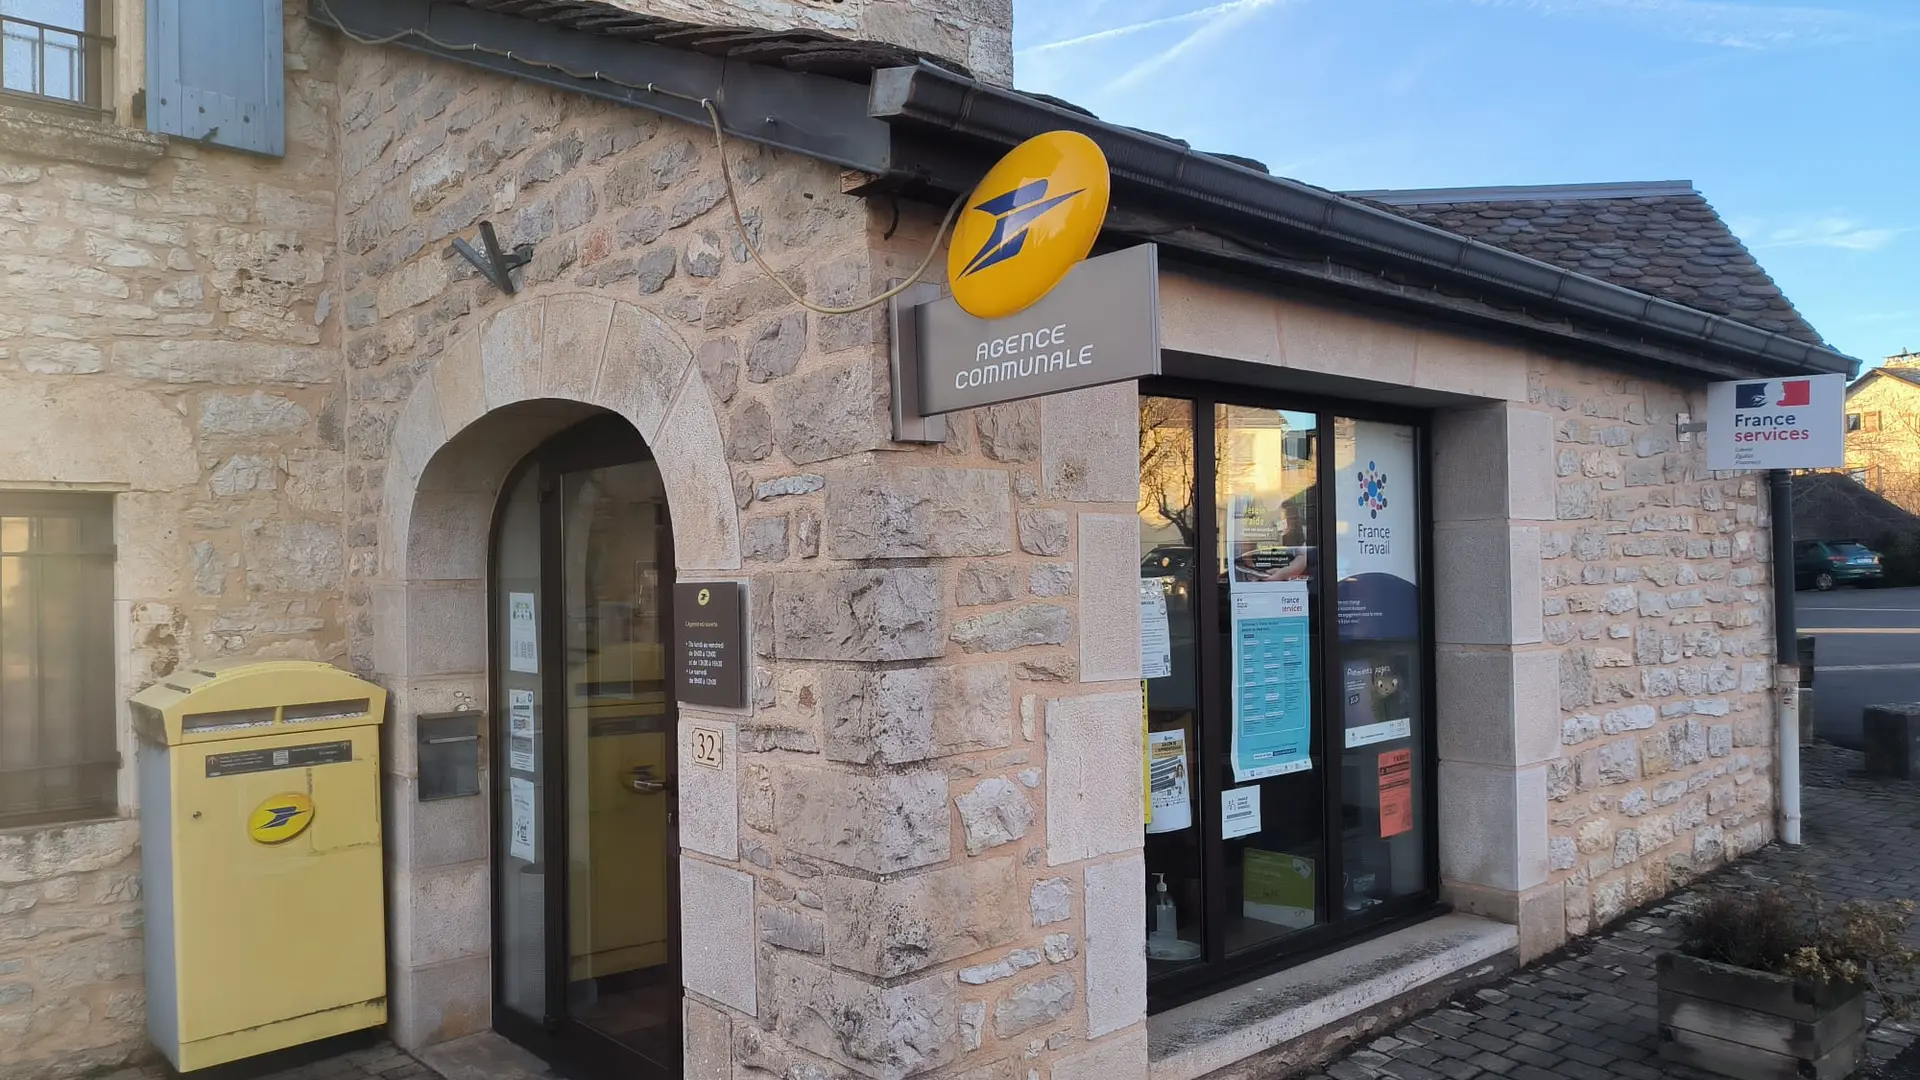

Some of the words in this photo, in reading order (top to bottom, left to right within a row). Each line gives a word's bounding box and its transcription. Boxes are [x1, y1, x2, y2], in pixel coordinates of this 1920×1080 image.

[976, 323, 1067, 362] AGENCE
[955, 344, 1094, 389] COMMUNALE
[1735, 414, 1796, 427] France
[1735, 427, 1809, 442] services
[1357, 523, 1390, 539] France
[1357, 539, 1390, 555] Travail
[1281, 596, 1300, 604] France
[1281, 605, 1303, 613] services
[697, 733, 715, 761] 32
